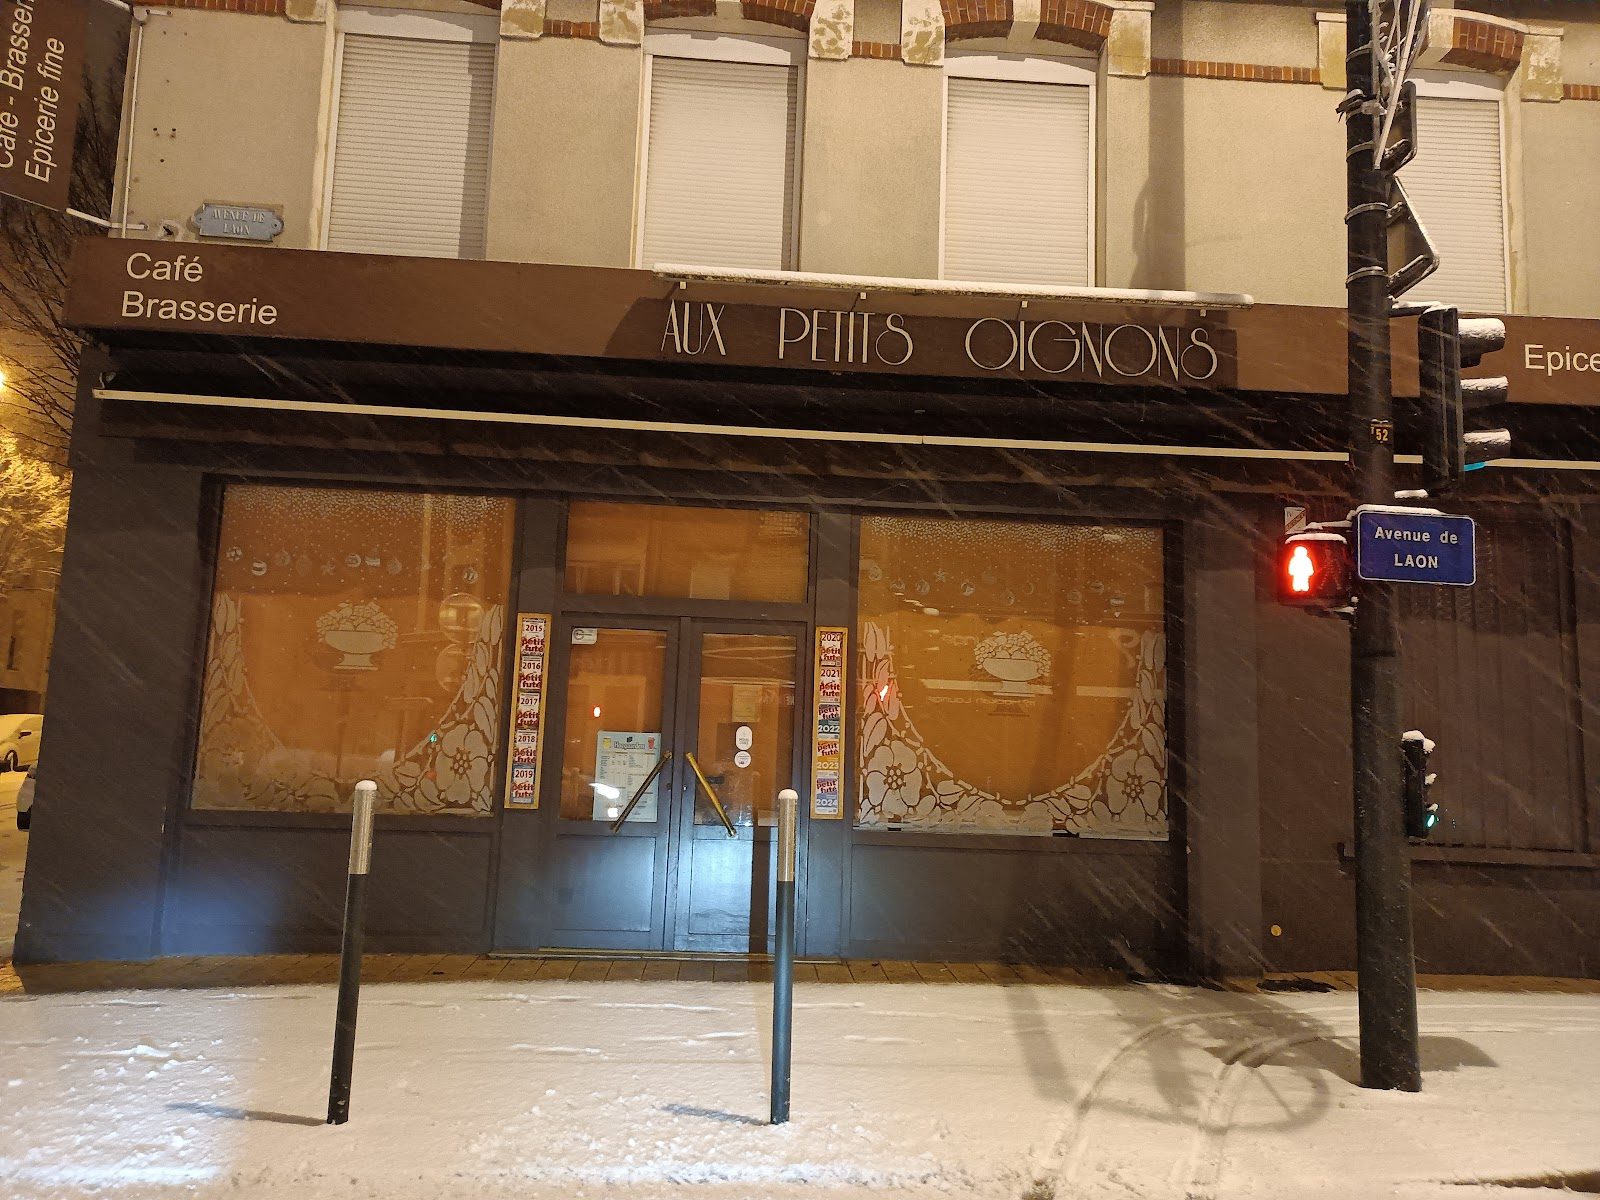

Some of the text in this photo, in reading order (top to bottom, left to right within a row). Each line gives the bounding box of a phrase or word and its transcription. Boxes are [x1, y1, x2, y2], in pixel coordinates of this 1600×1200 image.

[0, 0, 34, 91] Brasser
[24, 37, 65, 183] Epicerie fine
[252, 213, 265, 223] DE
[223, 223, 250, 235] LAON
[126, 252, 203, 282] Café
[121, 290, 278, 325] Brasserie
[661, 299, 1218, 382] AUX PETITS OIGNONS
[1524, 343, 1600, 377] Epice
[1375, 428, 1389, 442] 52
[1374, 526, 1458, 544] Avenue de
[1394, 553, 1438, 569] LAON
[525, 624, 543, 632] 2015
[821, 633, 841, 642] 2020
[522, 662, 541, 670] 2016
[820, 669, 840, 677] 2021
[520, 697, 538, 705] 2017
[818, 725, 840, 733] 2022
[518, 735, 536, 743] 2018
[817, 761, 839, 770] 2023
[515, 769, 533, 778] 2019
[816, 799, 838, 807] 2024
